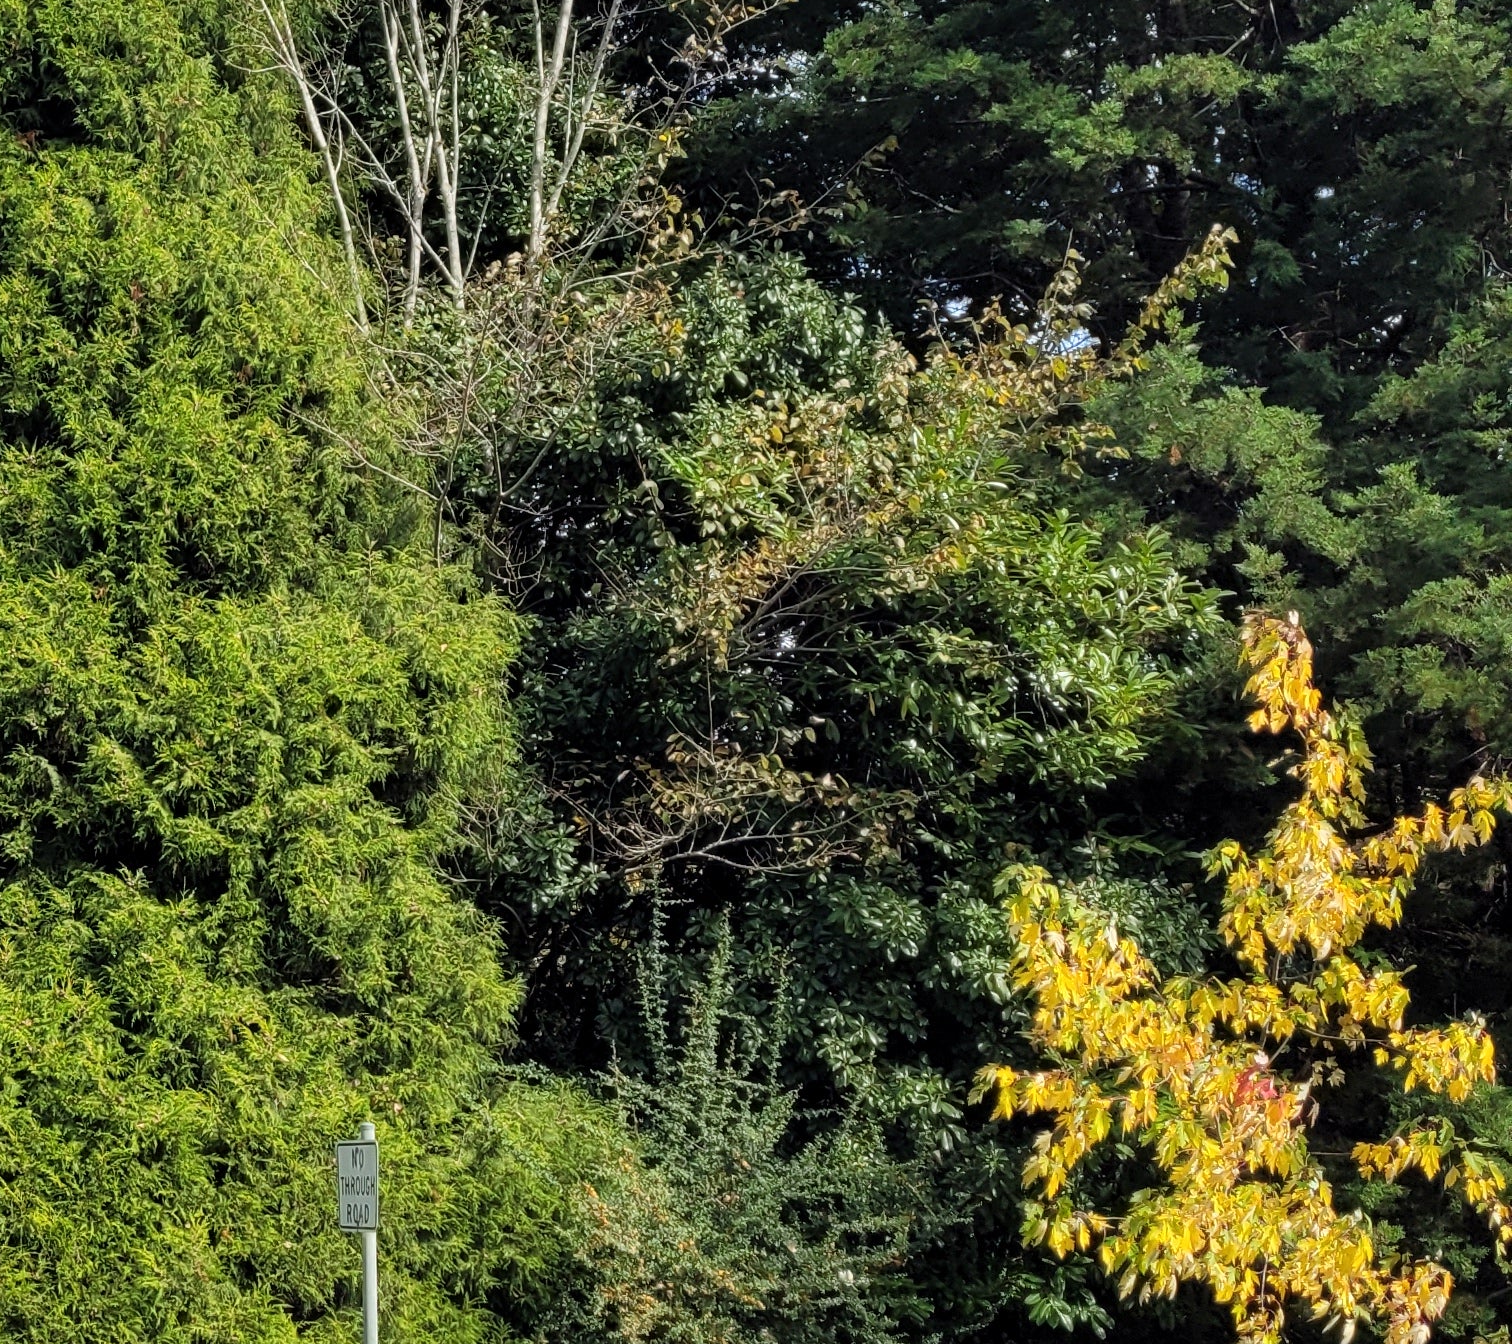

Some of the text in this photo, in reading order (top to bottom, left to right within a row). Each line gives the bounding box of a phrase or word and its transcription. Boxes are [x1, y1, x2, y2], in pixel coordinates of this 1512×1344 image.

[351, 1147, 364, 1169] NO
[340, 1176, 375, 1196] THROUGH
[346, 1203, 370, 1224] ROAD
